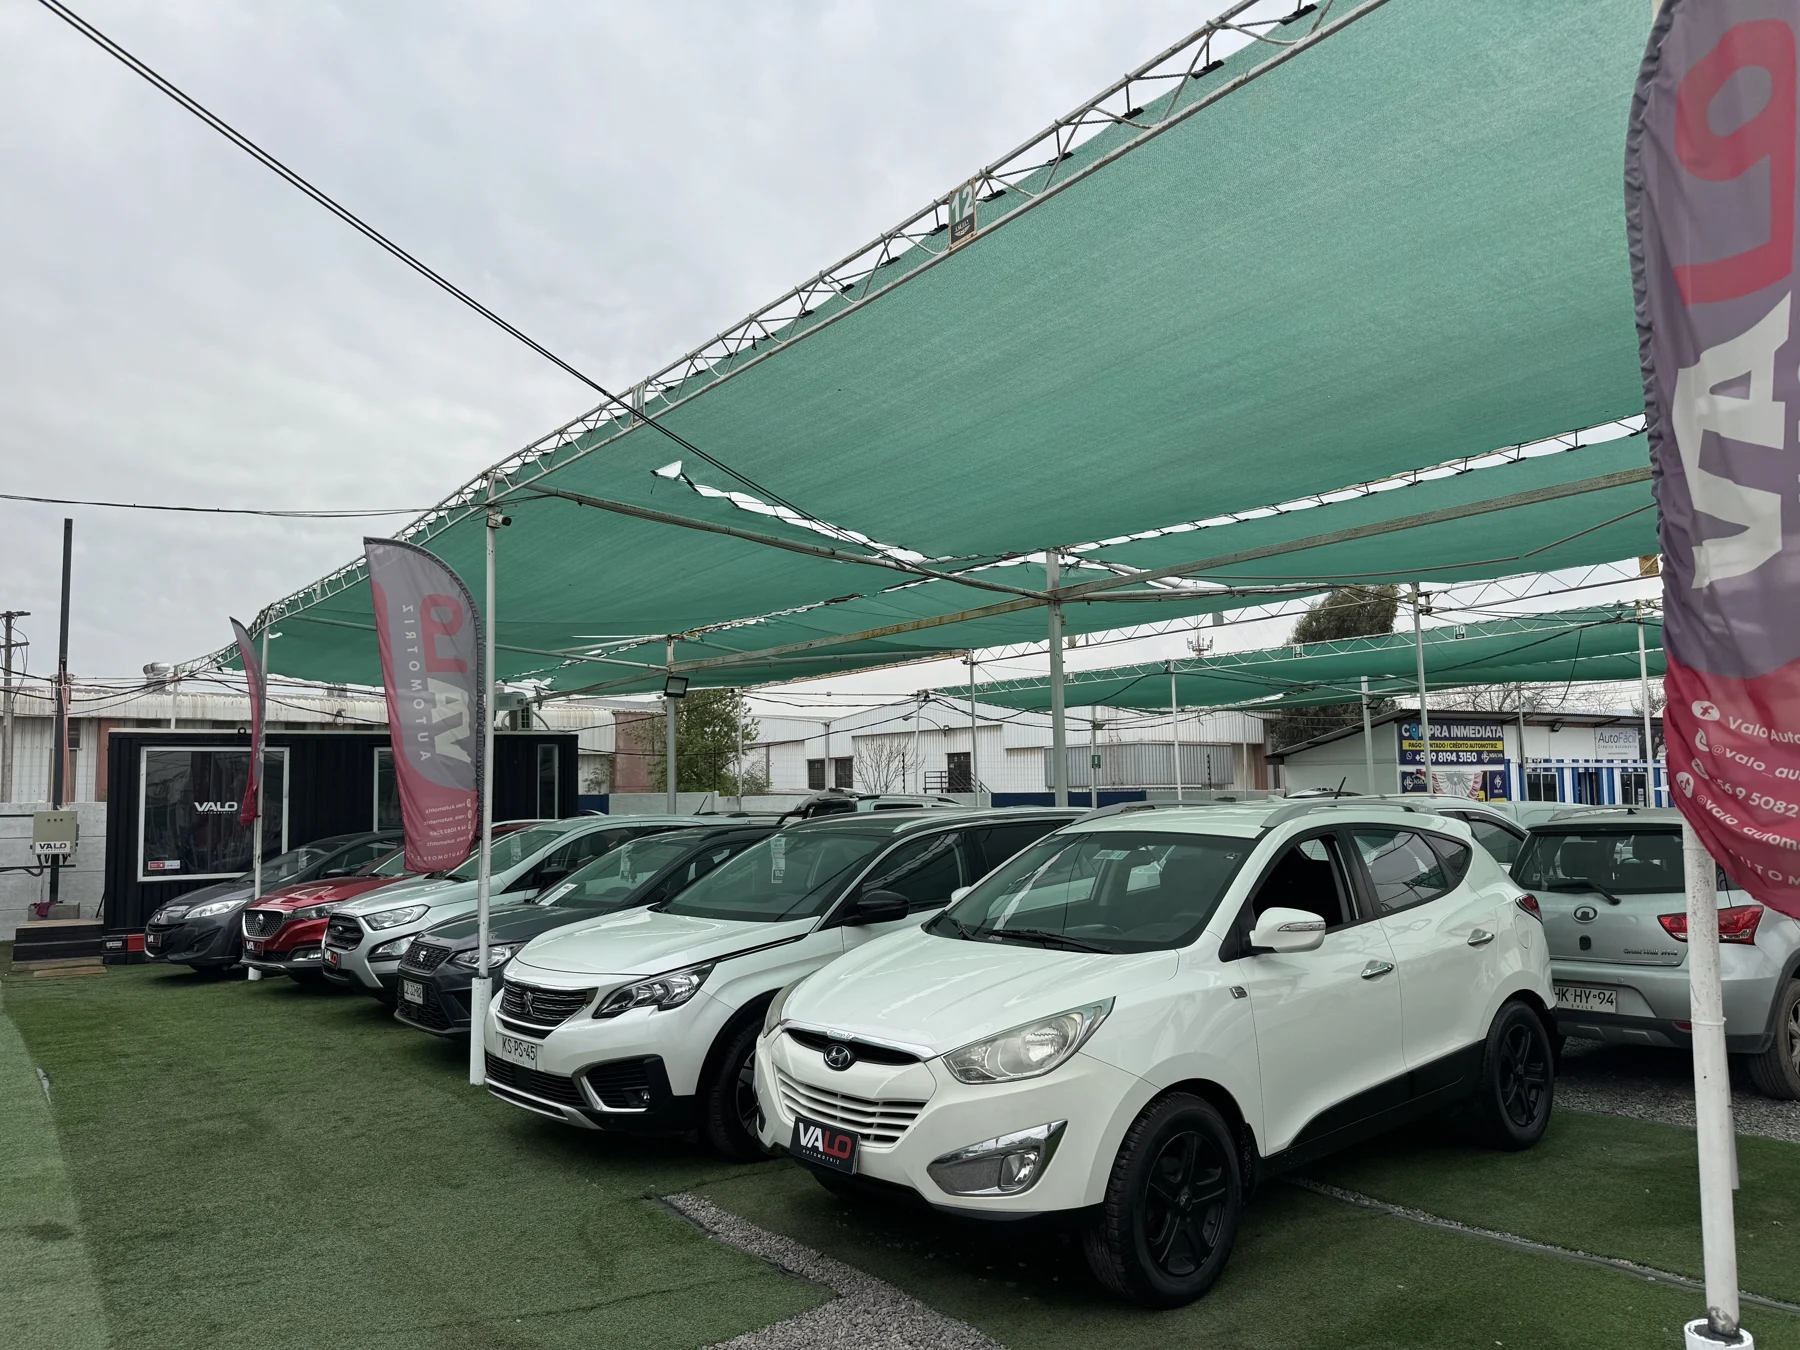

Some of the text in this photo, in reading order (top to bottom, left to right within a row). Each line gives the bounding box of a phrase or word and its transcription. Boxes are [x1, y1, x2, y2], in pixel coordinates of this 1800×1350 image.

[951, 184, 974, 223] 12
[1672, 18, 1797, 589] VALO
[1455, 625, 1465, 635] 10
[1450, 725, 1504, 738] INMEDIATA
[1728, 716, 1768, 738] Valo
[1438, 752, 1457, 762] 8194
[1458, 752, 1477, 762] 3150
[194, 801, 238, 812] VALO
[1736, 787, 1746, 800] 9
[1748, 792, 1799, 818] 5082
[1696, 794, 1800, 851] @valo_autom
[39, 842, 67, 850] VALO
[798, 1122, 852, 1159] VALO
[802, 1149, 840, 1165] AUTOMOTRIZ
